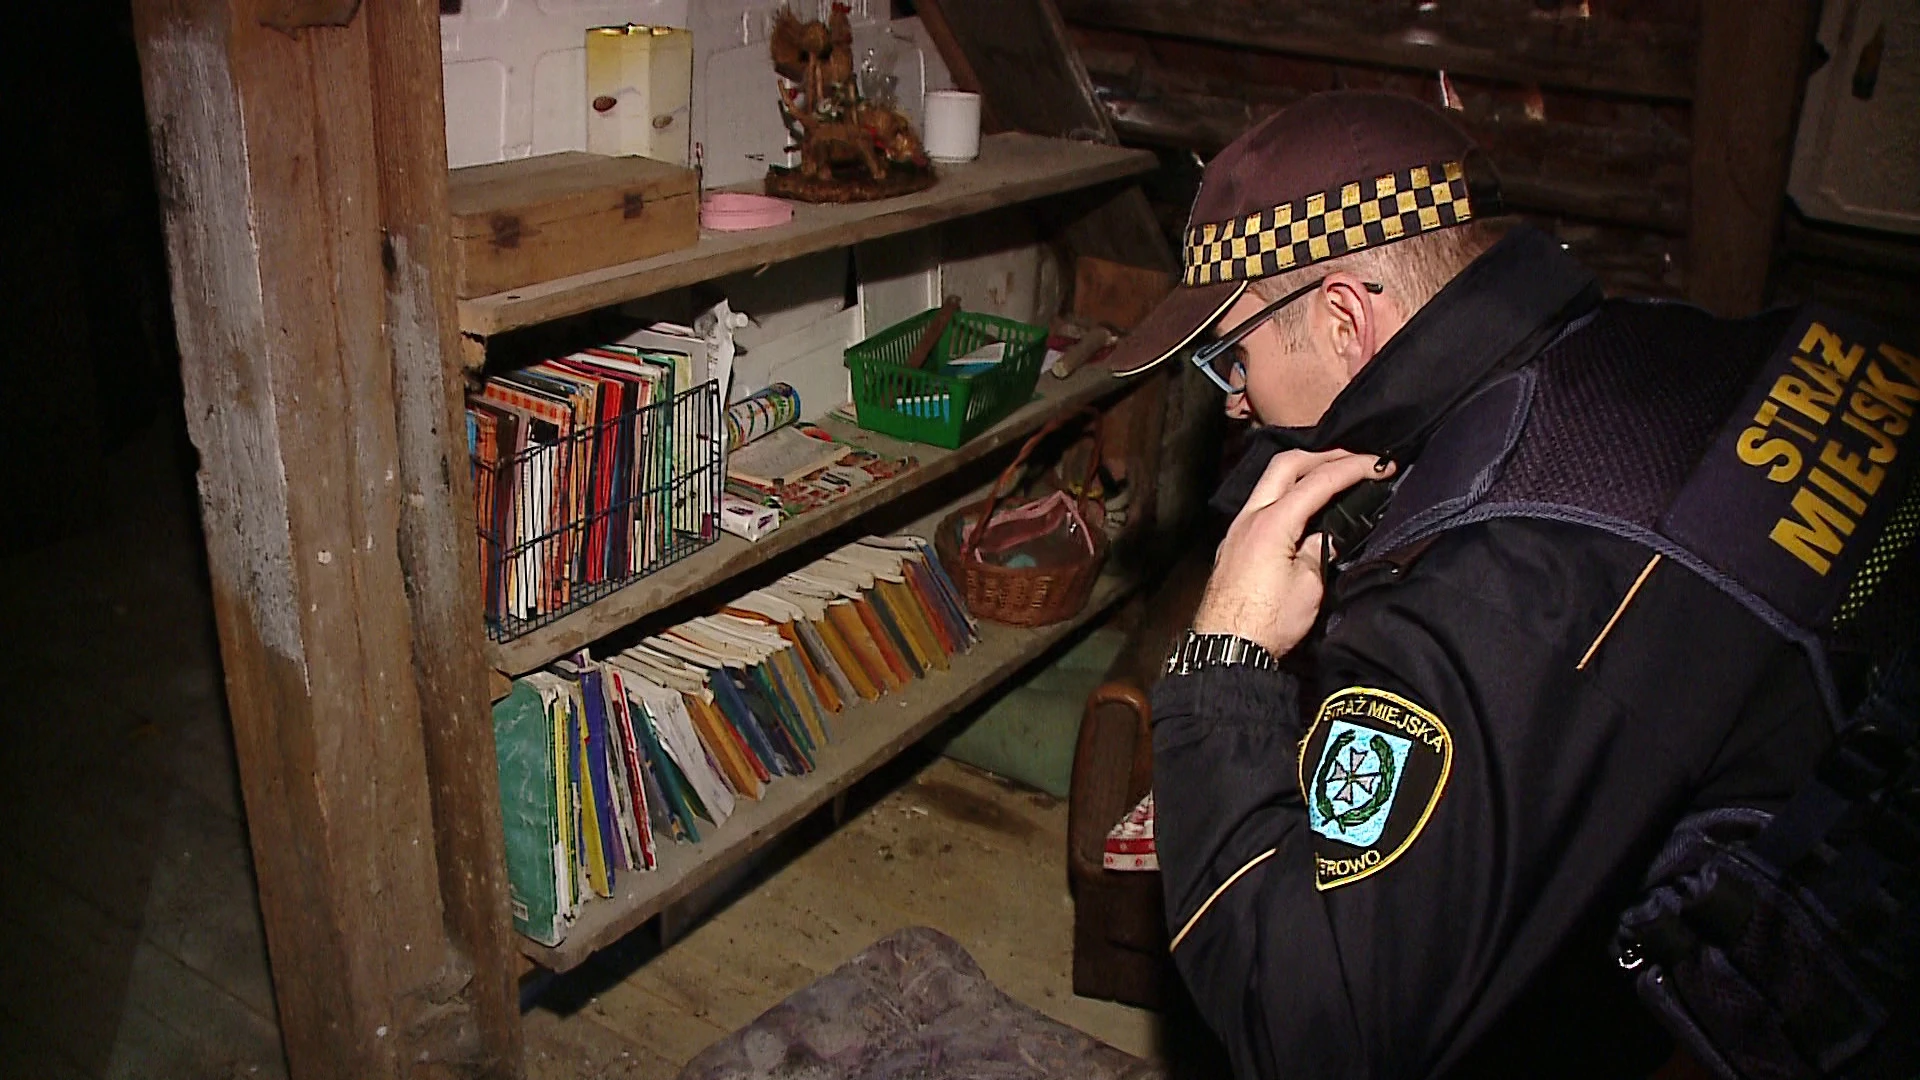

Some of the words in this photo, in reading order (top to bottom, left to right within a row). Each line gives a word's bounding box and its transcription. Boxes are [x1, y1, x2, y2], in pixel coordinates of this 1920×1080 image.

[1769, 344, 1920, 577] MIEJSKA
[1323, 696, 1367, 722] STRAŻ
[1367, 700, 1445, 754] MIEJSKA
